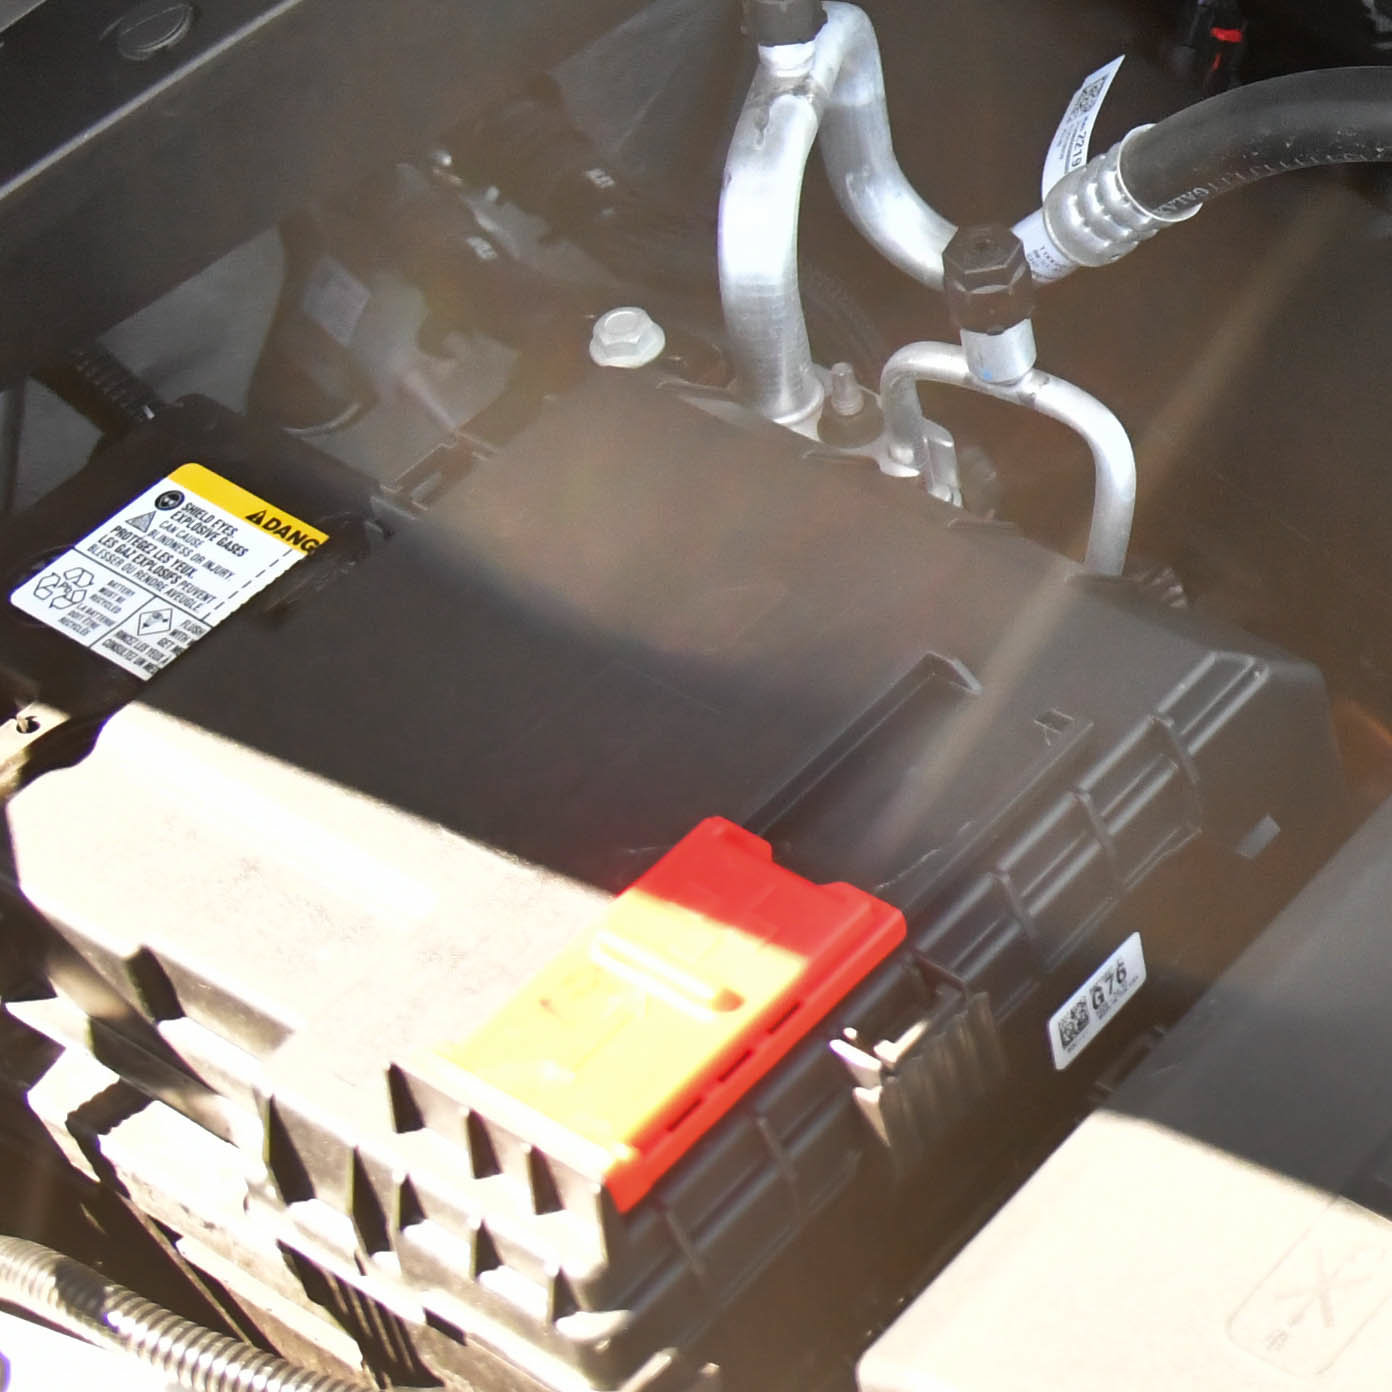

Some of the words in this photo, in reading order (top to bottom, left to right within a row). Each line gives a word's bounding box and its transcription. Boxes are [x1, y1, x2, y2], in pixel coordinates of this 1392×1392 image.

[180, 501, 216, 524] SHIELD
[146, 528, 195, 558] BLINDNESS
[188, 552, 207, 564] OR
[157, 519, 180, 534] CAN
[173, 528, 206, 548] CAUSE
[169, 510, 220, 541] EXPLOSIVE
[214, 536, 249, 557] GASES
[261, 516, 320, 553] DANG
[85, 543, 126, 567] BLESSER
[131, 569, 169, 592] RENDRE
[96, 533, 120, 549] LES
[112, 543, 138, 559] GAZ
[130, 552, 183, 585] EXPLOSIFS
[175, 579, 217, 604] PEUVENT
[151, 549, 175, 564] LES
[1090, 957, 1127, 1010] G76
